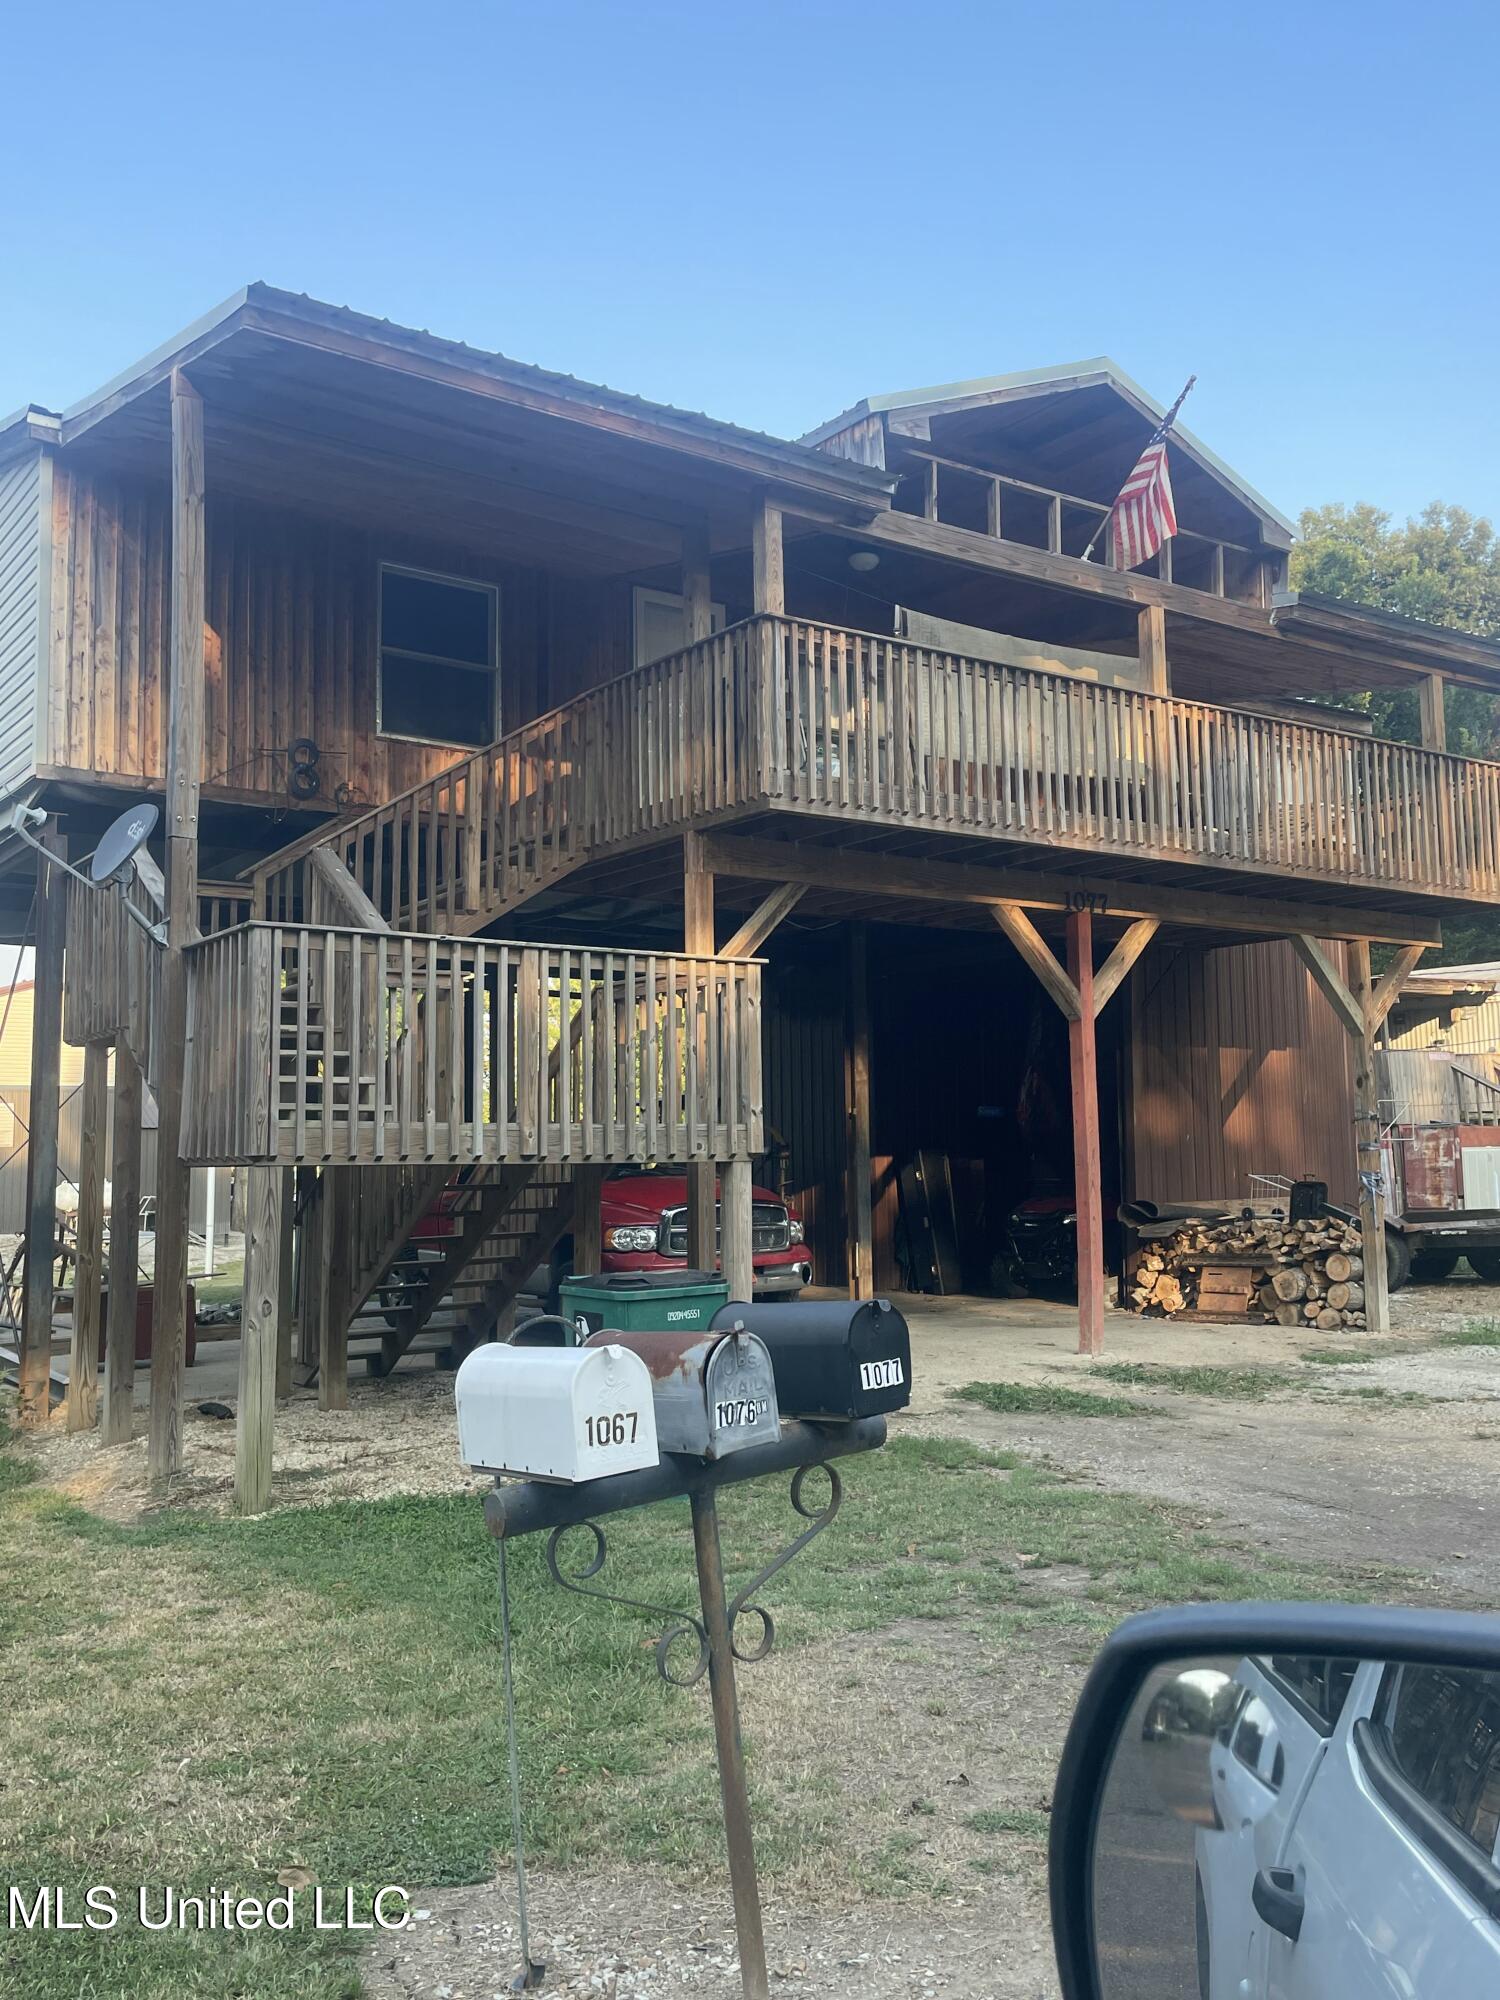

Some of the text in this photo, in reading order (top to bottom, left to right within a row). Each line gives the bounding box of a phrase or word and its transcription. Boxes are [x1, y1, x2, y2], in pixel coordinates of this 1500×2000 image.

[1064, 891, 1108, 914] 1077
[863, 1360, 900, 1387] 1077
[724, 1377, 764, 1399] MAIL
[717, 1400, 755, 1428] 1076
[585, 1411, 638, 1447] 1067
